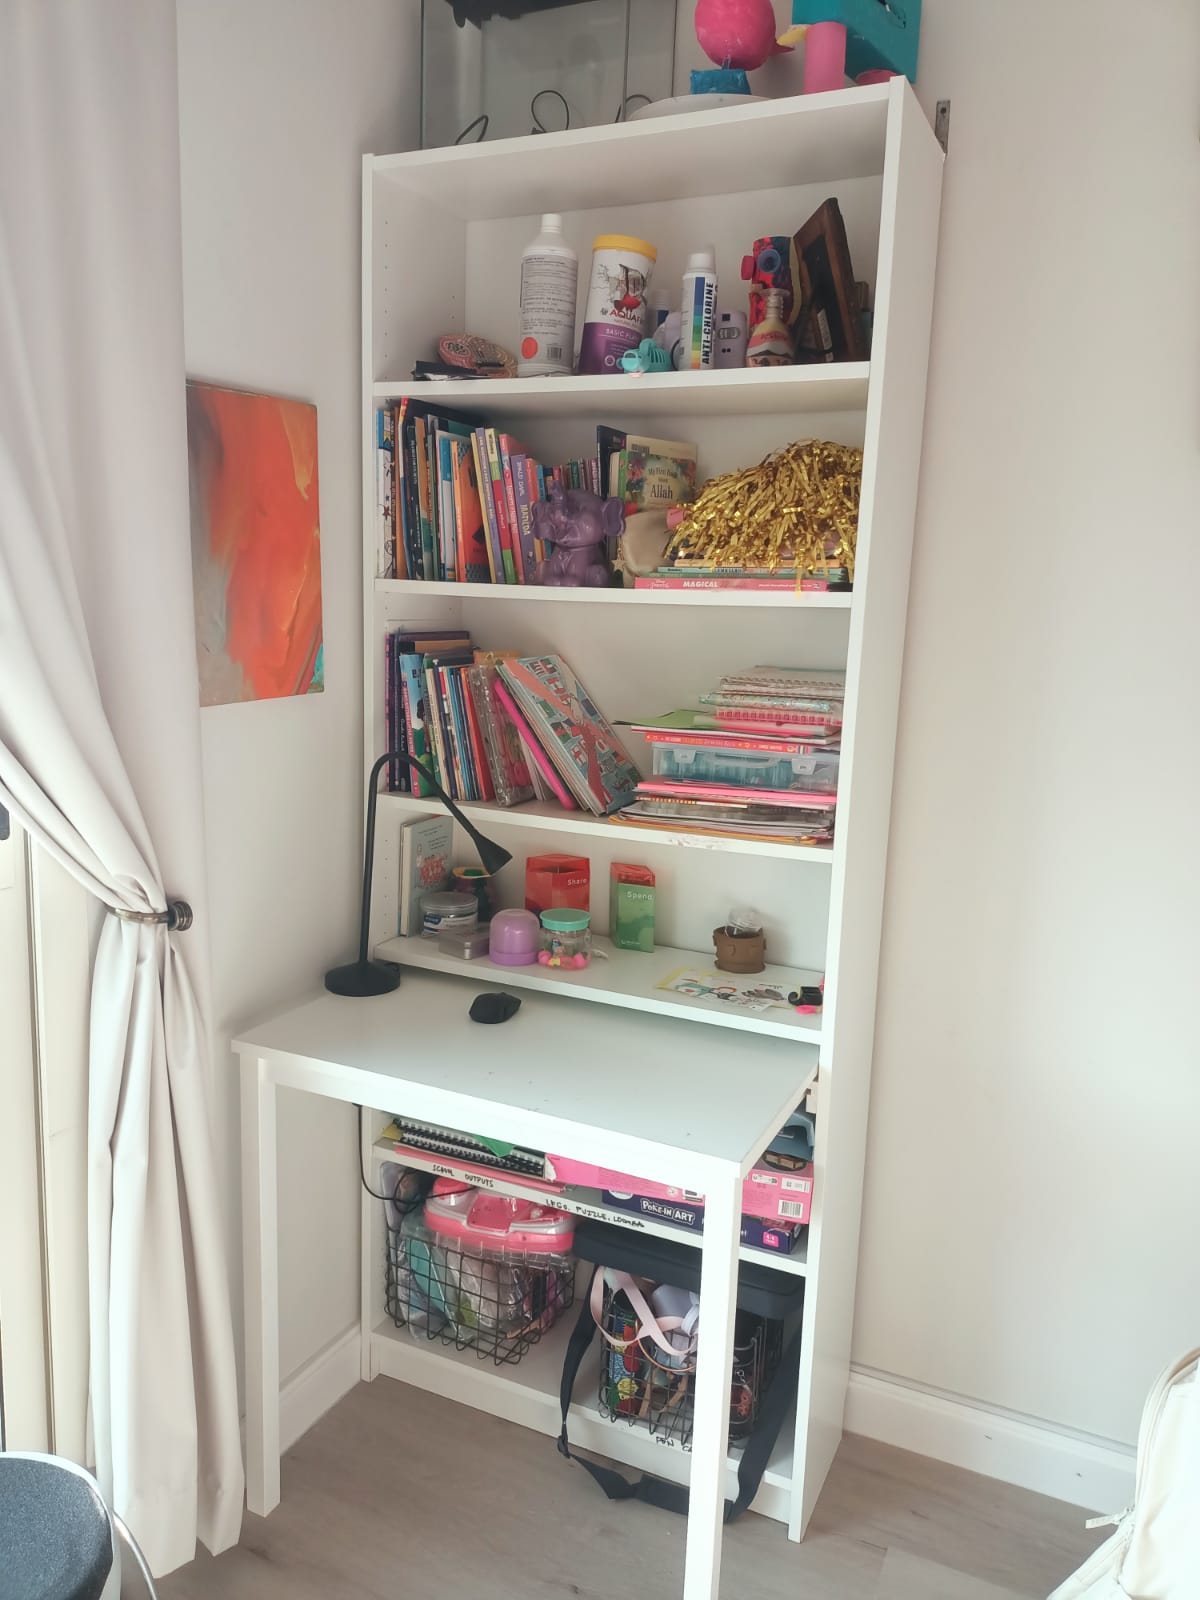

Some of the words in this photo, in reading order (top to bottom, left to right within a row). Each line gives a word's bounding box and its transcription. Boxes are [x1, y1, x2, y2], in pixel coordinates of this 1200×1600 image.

[702, 282, 714, 365] ANTI-CHLORINE
[650, 484, 673, 499] Allah
[520, 504, 531, 536] MATILDA
[567, 878, 587, 886] Share
[464, 1173, 494, 1188] OUTPUTS
[674, 1210, 695, 1223] ART
